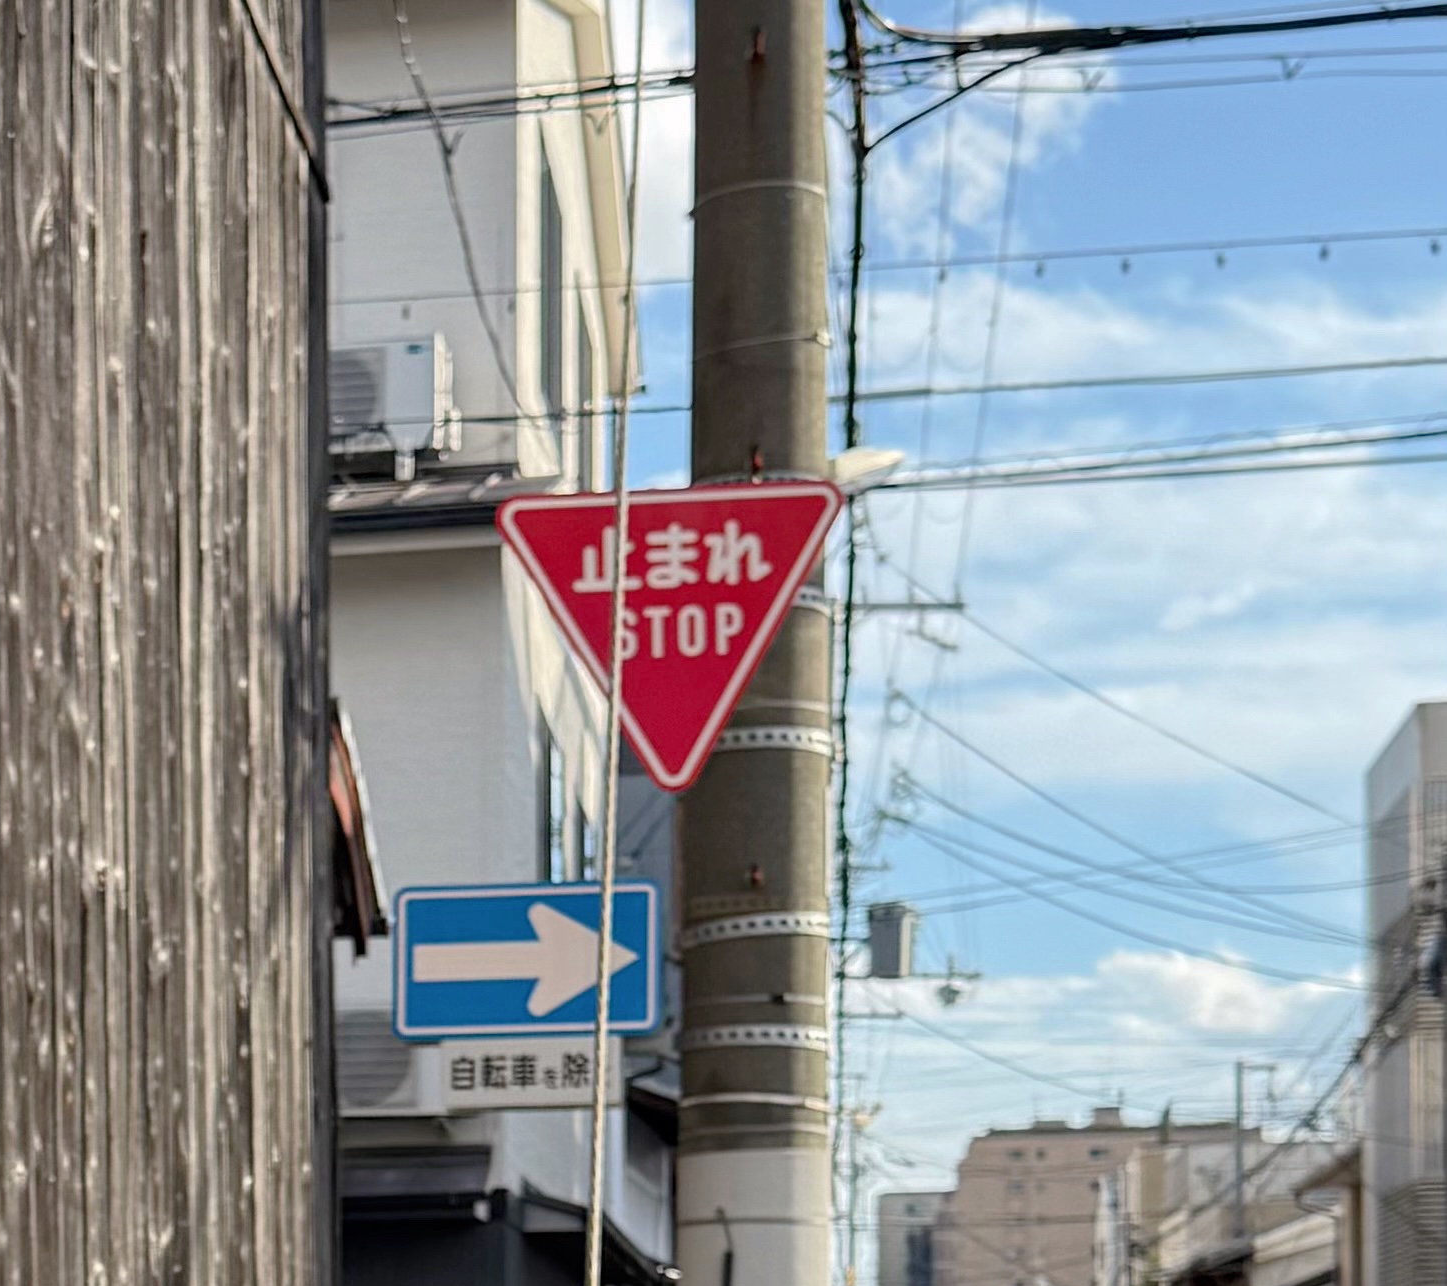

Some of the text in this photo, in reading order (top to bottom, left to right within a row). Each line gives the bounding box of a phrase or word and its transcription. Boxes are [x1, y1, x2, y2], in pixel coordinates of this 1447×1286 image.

[571, 519, 774, 594] 止まれ
[614, 602, 745, 661] STOP
[451, 1052, 613, 1092] 自転車を除
